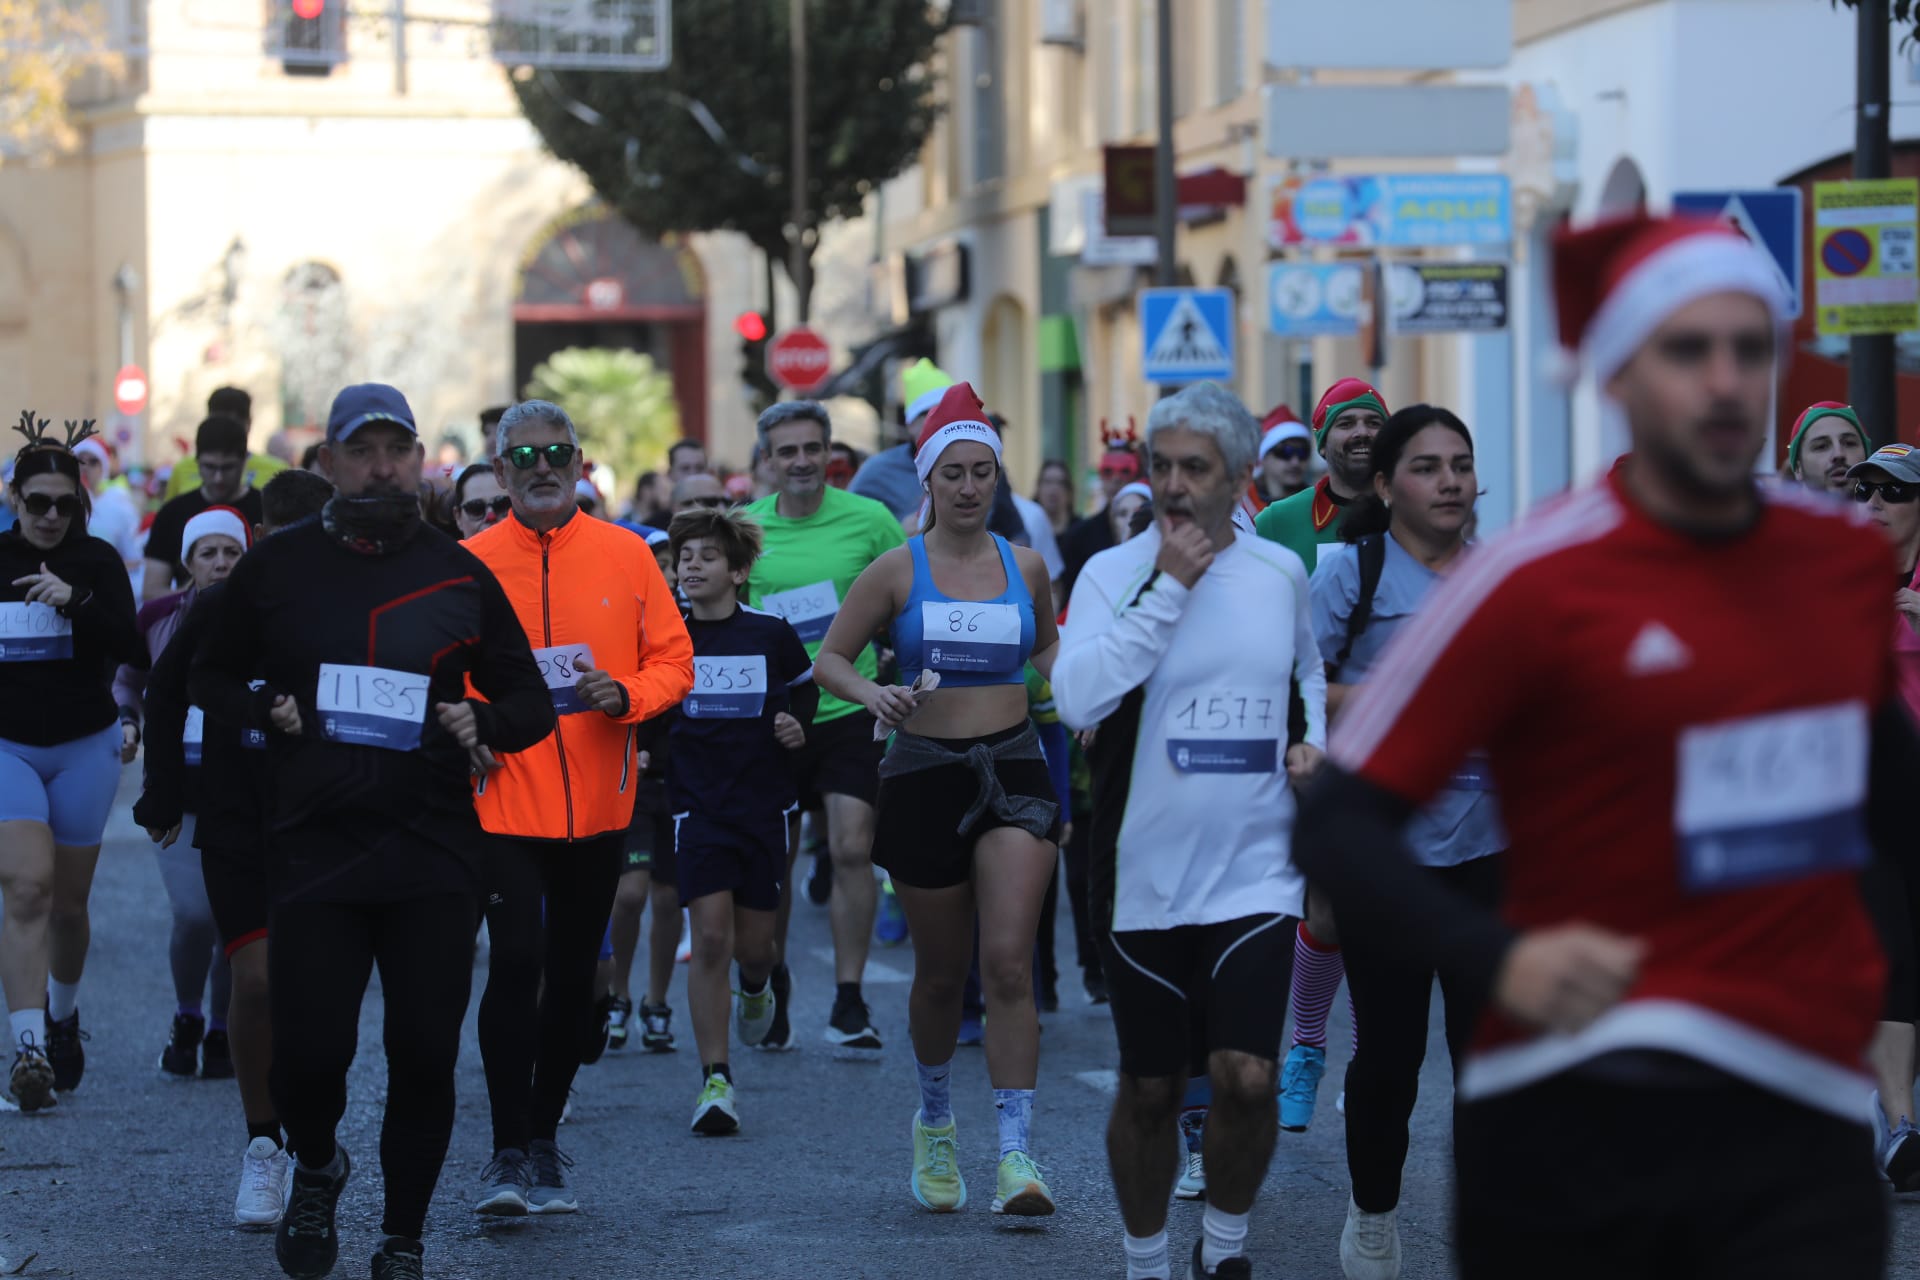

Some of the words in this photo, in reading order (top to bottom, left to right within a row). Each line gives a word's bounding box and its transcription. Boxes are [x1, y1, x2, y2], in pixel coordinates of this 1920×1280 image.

[773, 347, 827, 371] STOP
[944, 423, 988, 435] OKEYMAS
[949, 610, 985, 632] 86
[335, 673, 426, 716] 1185
[1177, 697, 1273, 730] 1577
